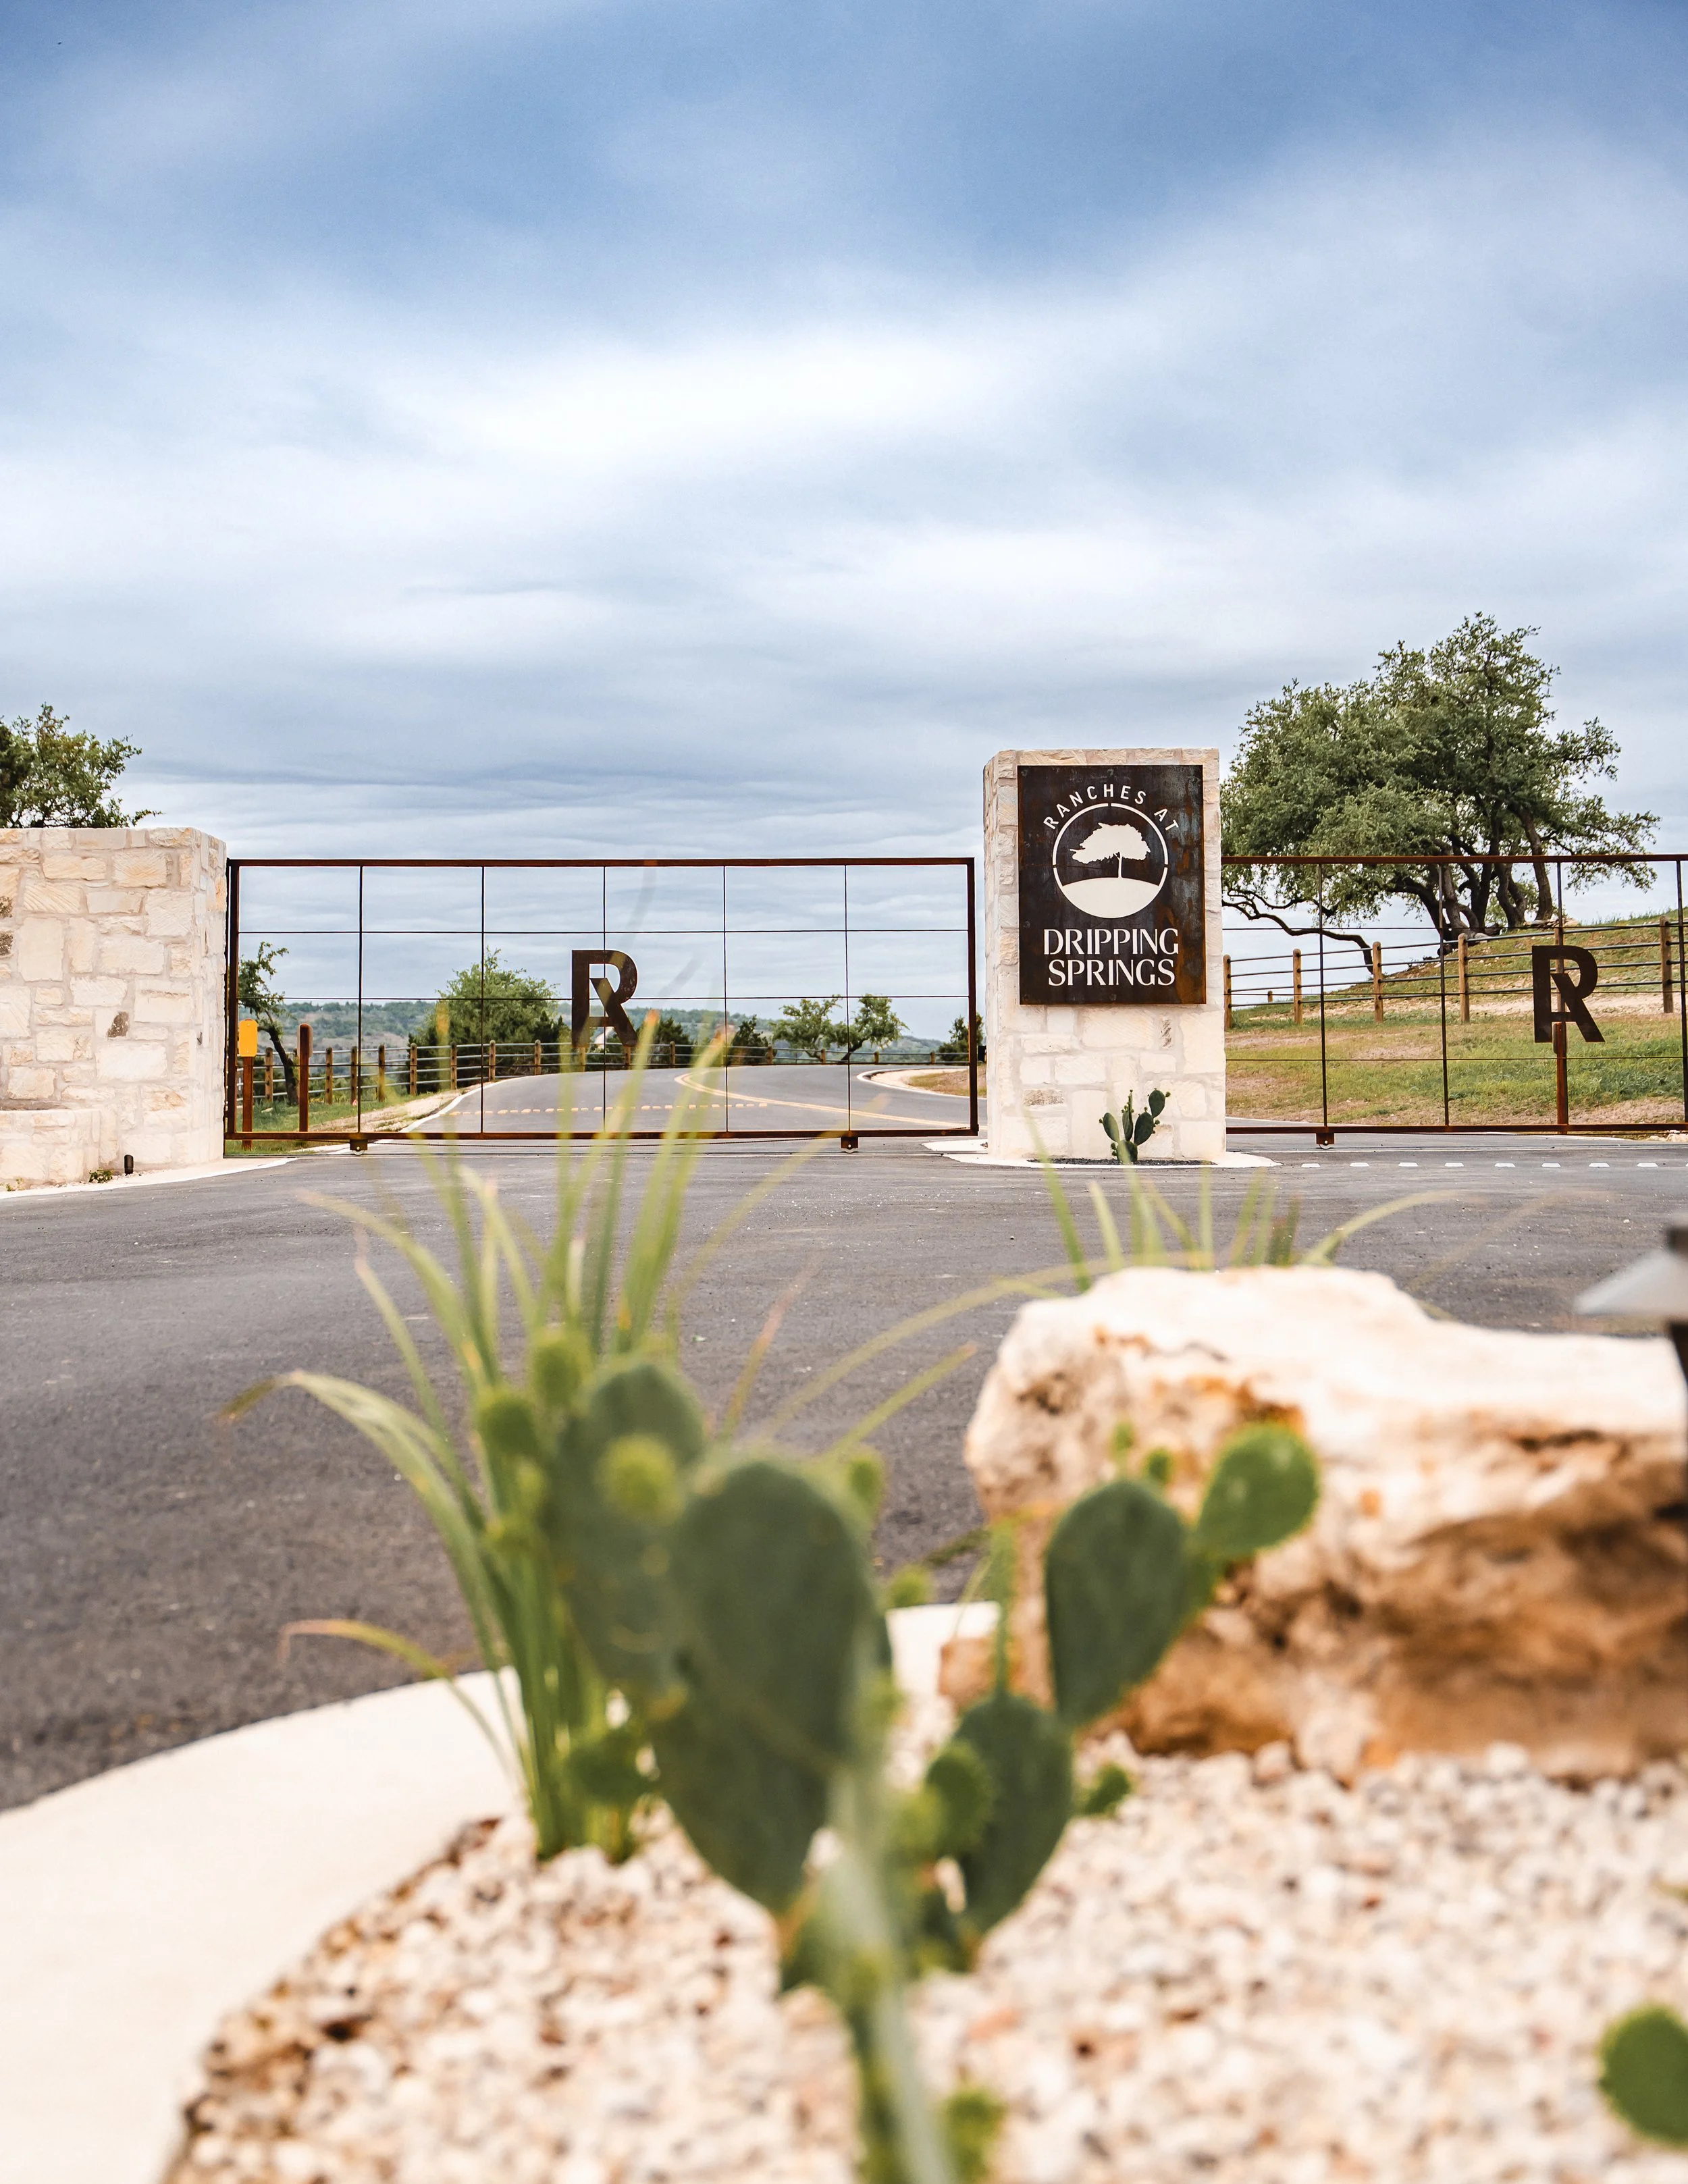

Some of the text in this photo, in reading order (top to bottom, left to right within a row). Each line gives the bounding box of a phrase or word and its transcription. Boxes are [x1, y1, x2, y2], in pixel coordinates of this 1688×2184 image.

[1043, 783, 1179, 831] RANCHES AT
[1043, 928, 1179, 955] DRIPPING
[1048, 959, 1176, 986] SPRINGS
